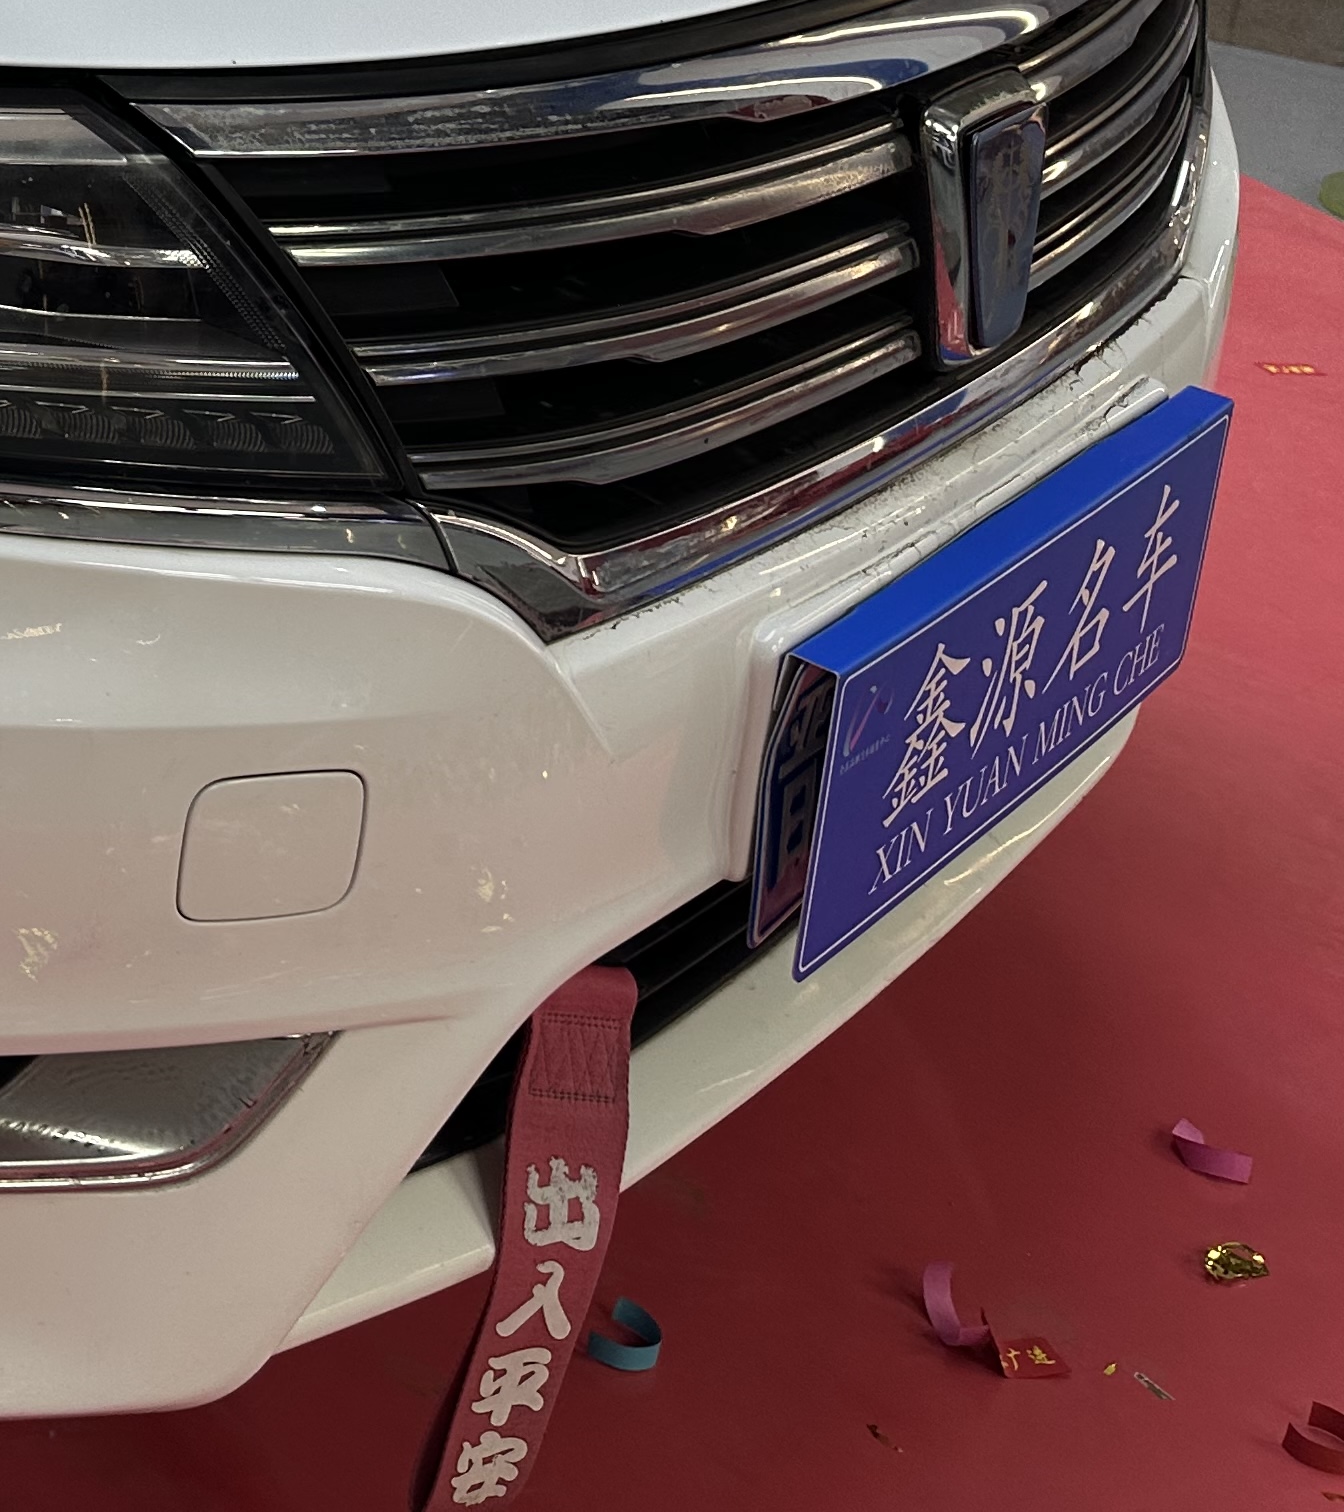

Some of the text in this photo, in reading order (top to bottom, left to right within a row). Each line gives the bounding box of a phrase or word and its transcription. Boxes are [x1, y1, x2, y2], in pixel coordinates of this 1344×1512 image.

[866, 807, 934, 897] XIN
[942, 733, 1029, 837] YUAN
[1031, 671, 1109, 765] MING
[1112, 622, 1166, 697] CHE
[881, 483, 1182, 830] 鑫源名车
[450, 1154, 601, 1507] 出入平安
